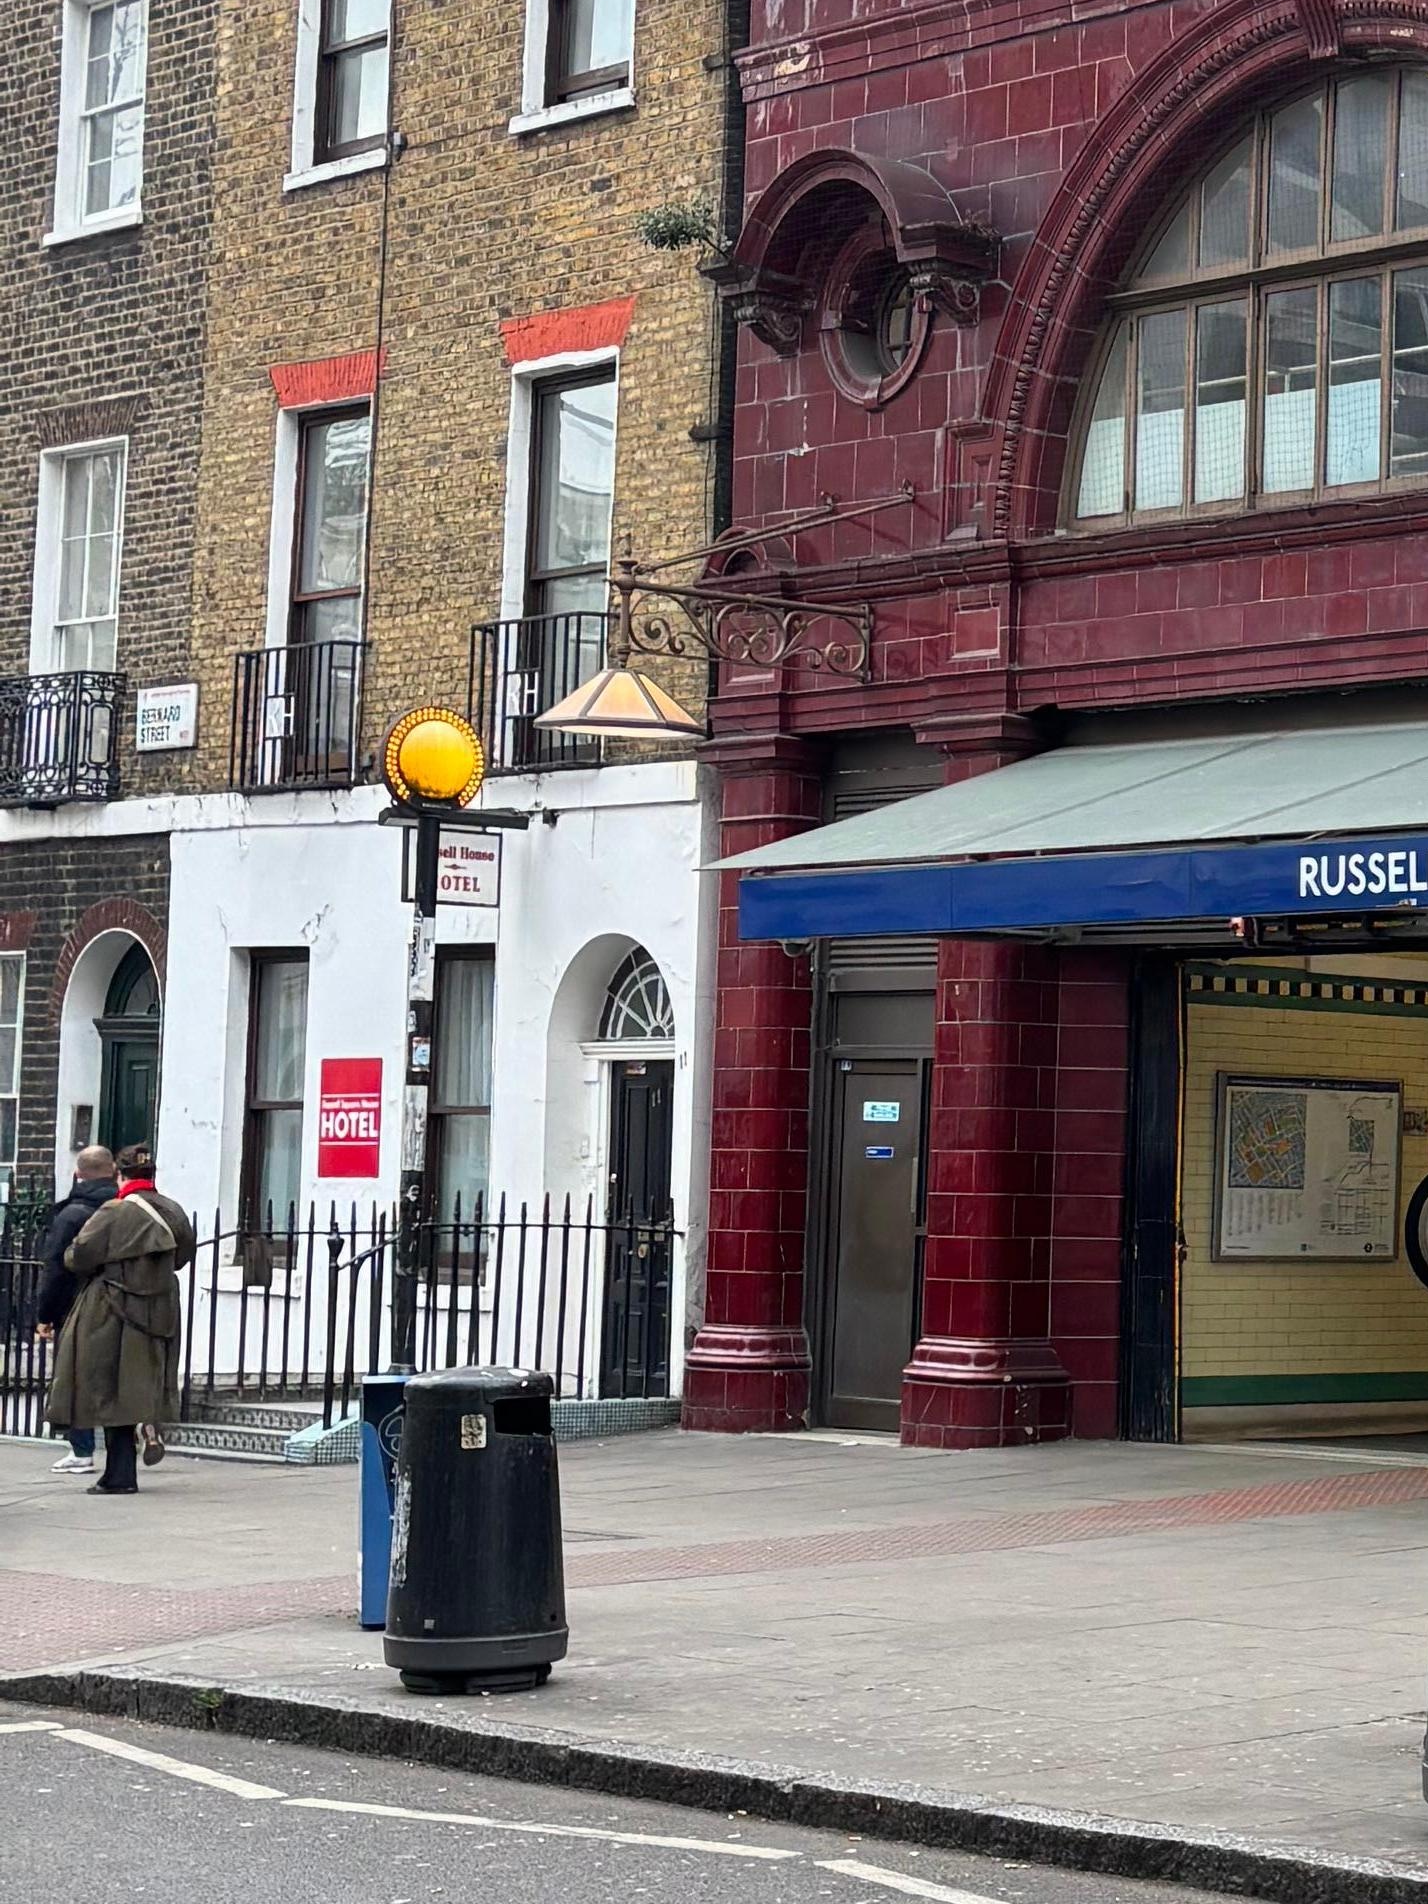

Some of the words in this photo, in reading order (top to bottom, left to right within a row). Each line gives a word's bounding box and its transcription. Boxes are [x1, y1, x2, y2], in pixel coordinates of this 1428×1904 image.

[141, 704, 181, 725] BERNARD
[140, 725, 171, 744] STREET
[460, 846, 495, 862] House
[441, 874, 481, 893] OTEL
[321, 1111, 379, 1139] HOTEL
